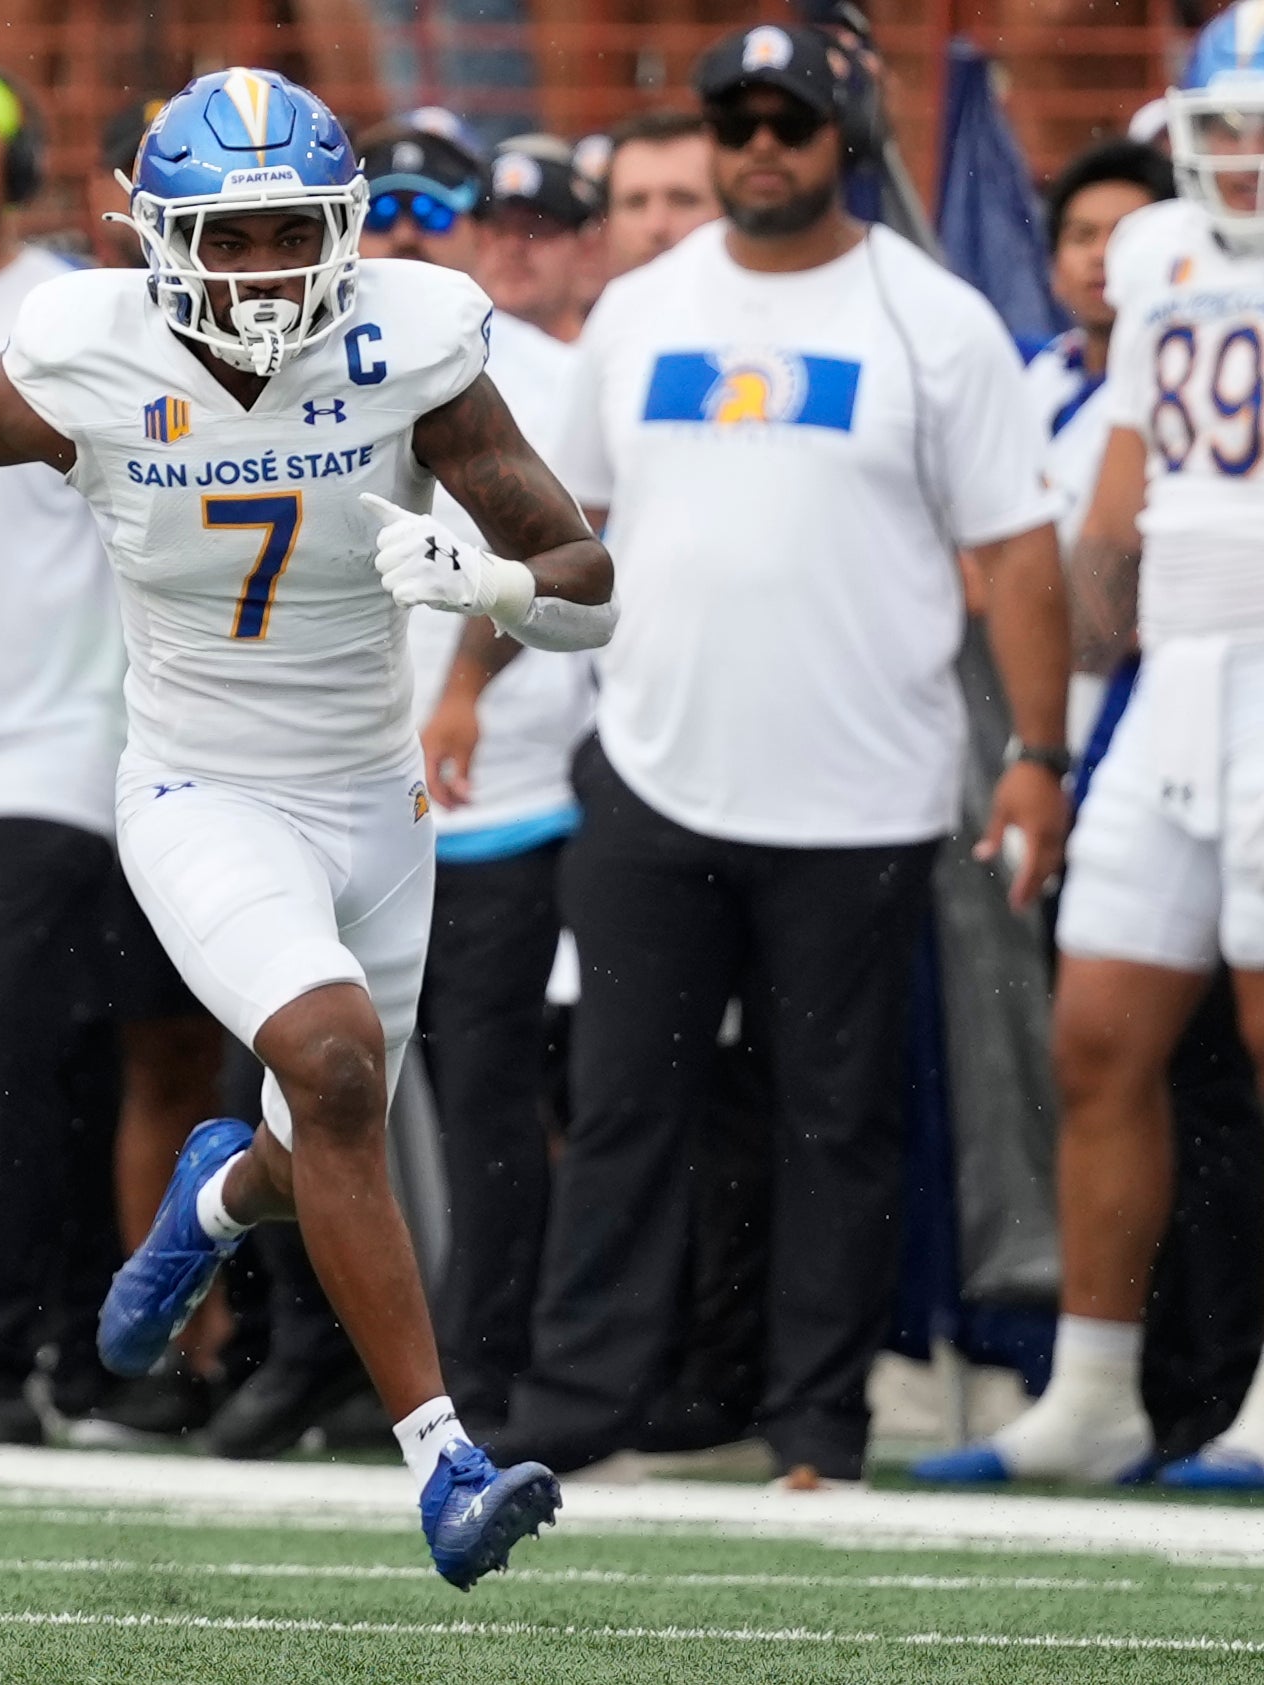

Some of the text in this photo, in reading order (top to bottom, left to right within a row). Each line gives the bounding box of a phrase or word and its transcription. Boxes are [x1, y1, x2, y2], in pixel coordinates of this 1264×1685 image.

[231, 171, 293, 184] SPARTANS
[344, 322, 387, 386] C
[1151, 324, 1263, 476] 89
[127, 443, 375, 488] SAN JOSÉ STATE
[200, 489, 303, 640] 7
